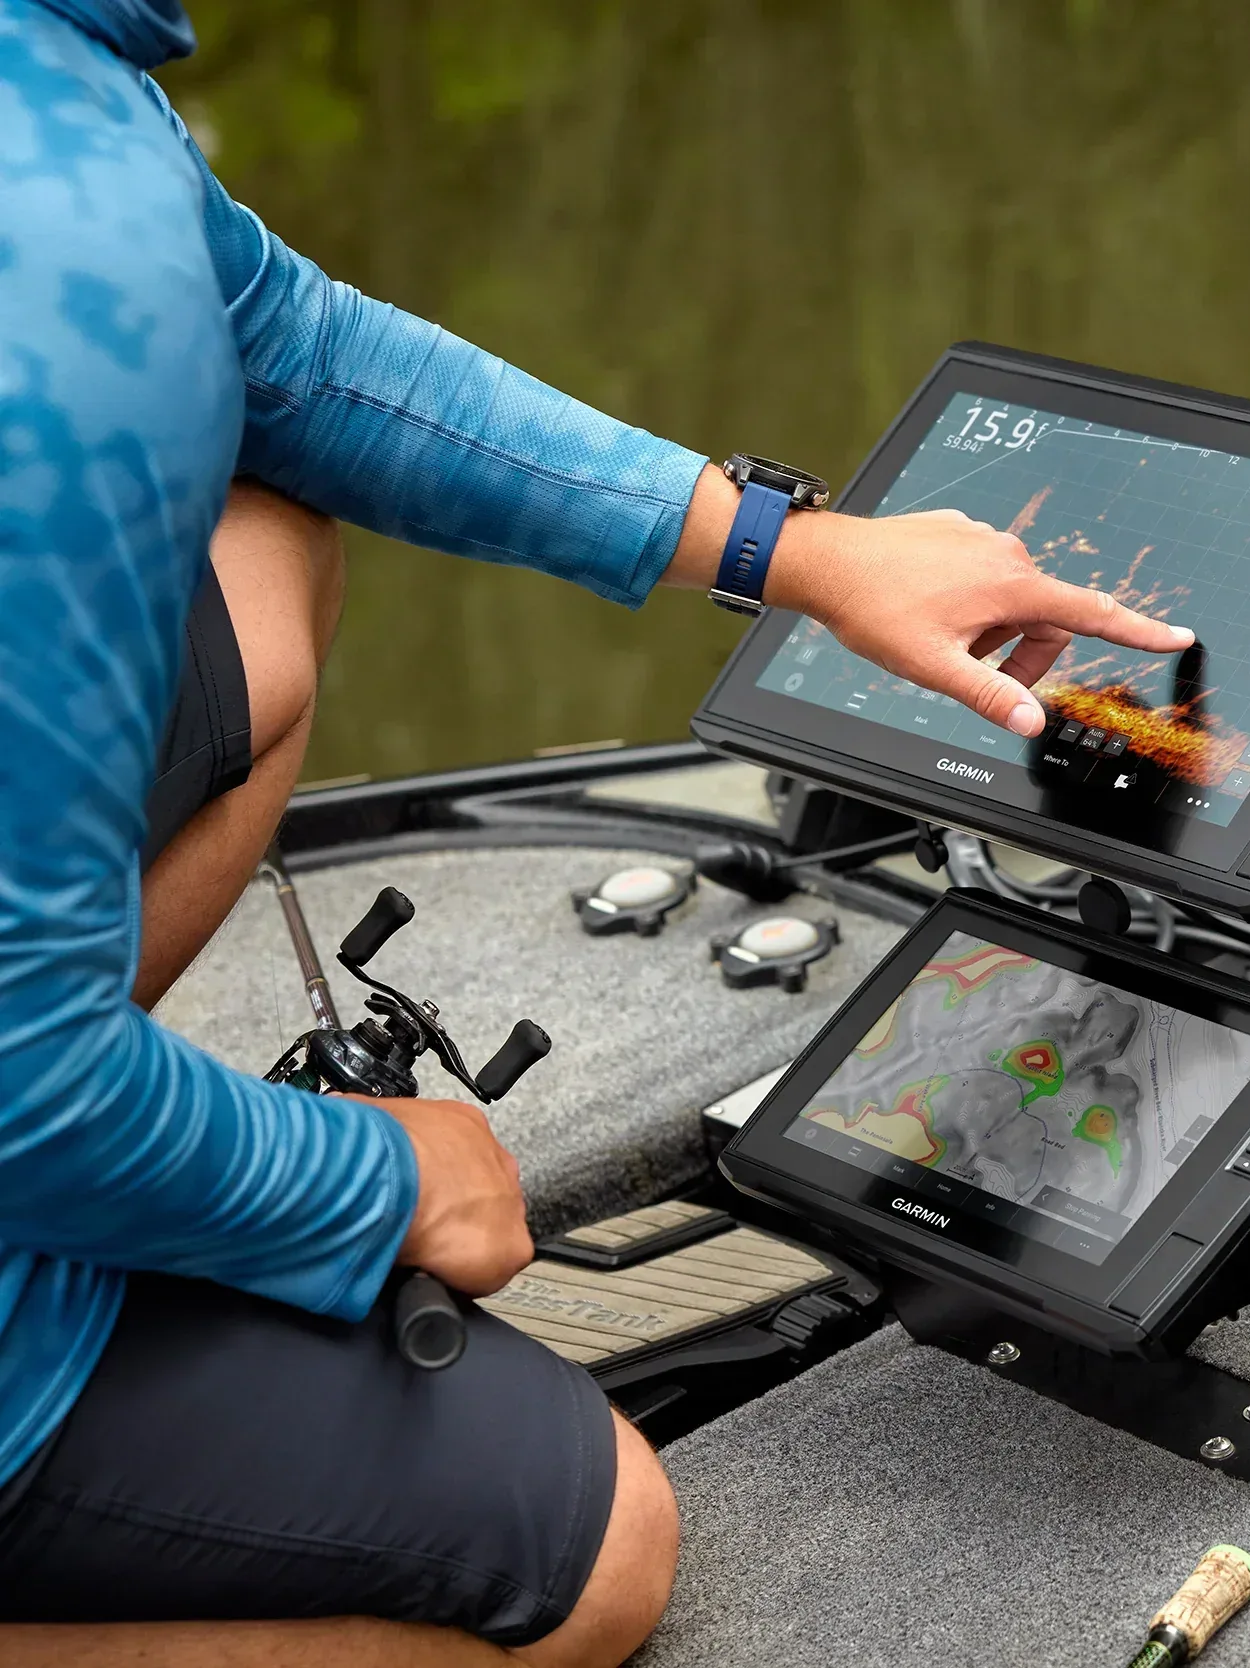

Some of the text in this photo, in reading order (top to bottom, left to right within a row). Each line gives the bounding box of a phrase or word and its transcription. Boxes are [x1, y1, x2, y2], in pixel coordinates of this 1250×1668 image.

[936, 414, 945, 424] 2
[958, 406, 1036, 449] 15.9
[1057, 416, 1066, 425] 0
[1084, 422, 1093, 431] 2
[1198, 449, 1211, 458] 10
[1227, 455, 1241, 465] 12
[914, 715, 929, 726] Mark
[1088, 728, 1104, 738] Auto
[979, 734, 997, 745] Home
[1082, 738, 1097, 748] 64%
[1043, 753, 1069, 767] Where To
[936, 758, 995, 784] GARMIN
[860, 1127, 869, 1135] The
[936, 1183, 952, 1193] Home
[985, 1202, 996, 1211] Info
[1064, 1202, 1079, 1214] Stop
[891, 1197, 951, 1229] GARMIN
